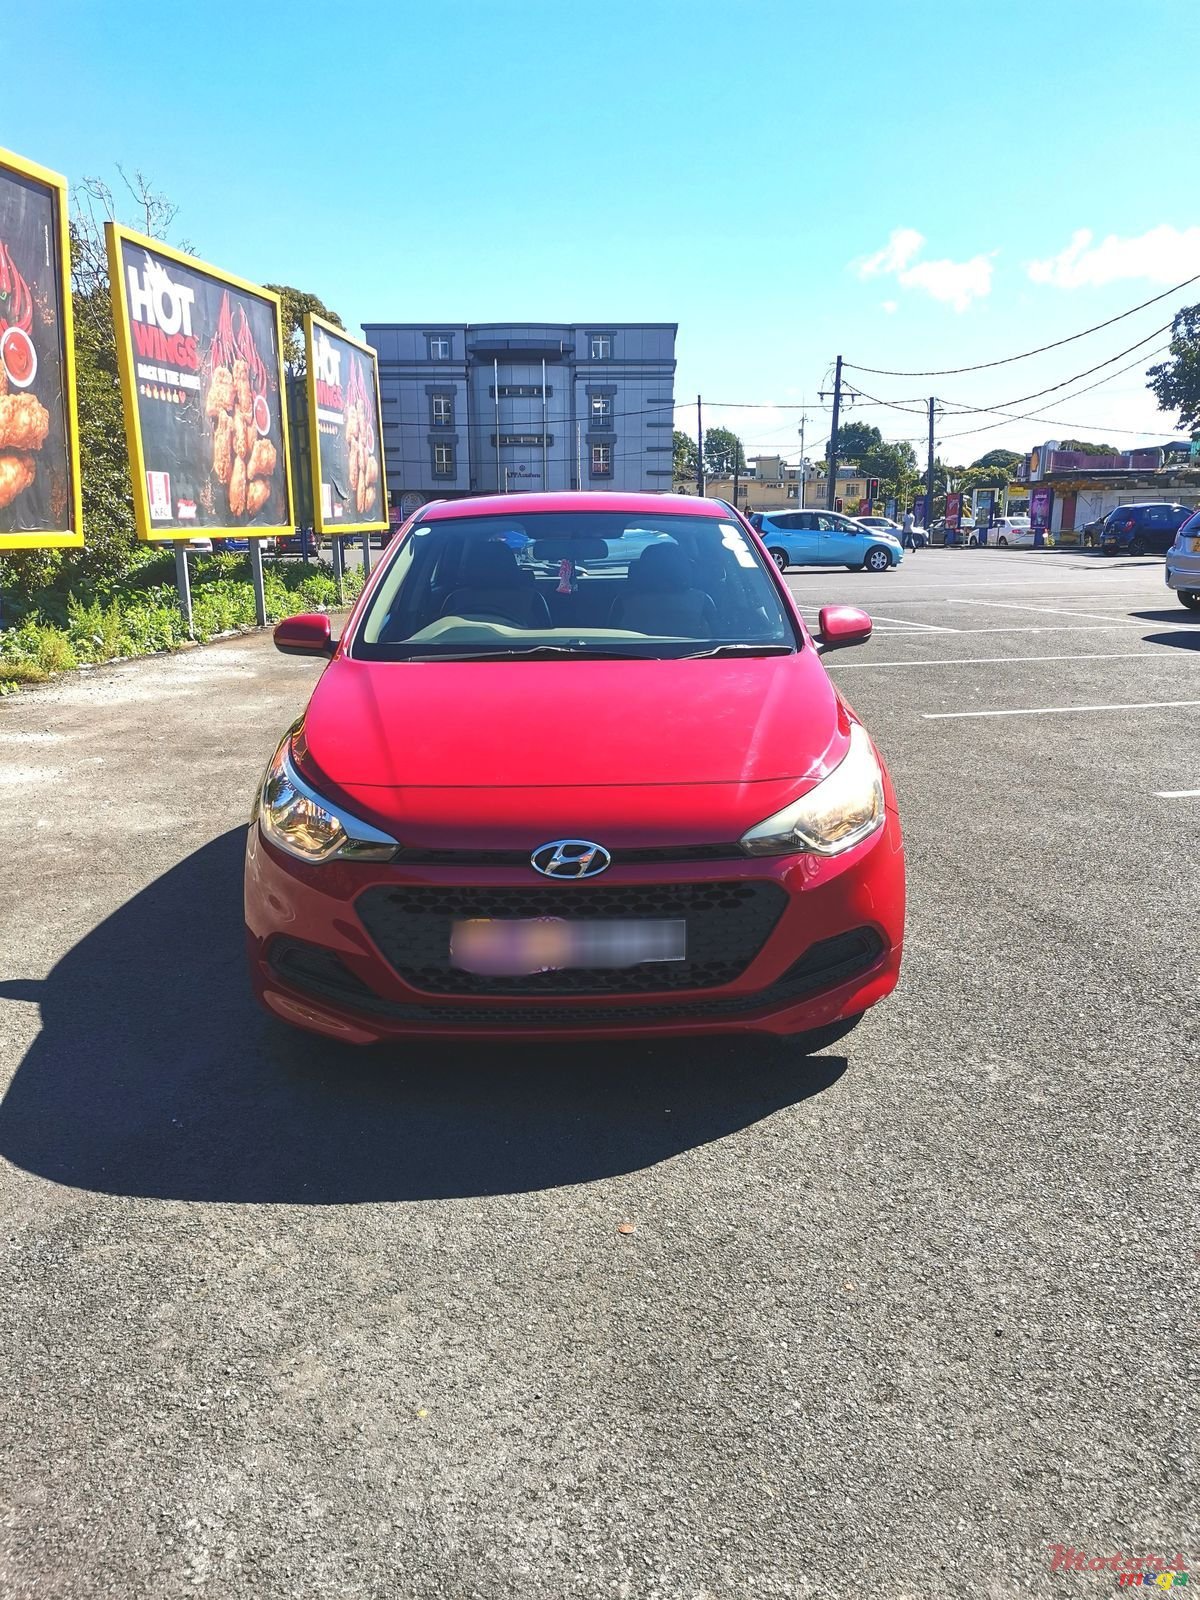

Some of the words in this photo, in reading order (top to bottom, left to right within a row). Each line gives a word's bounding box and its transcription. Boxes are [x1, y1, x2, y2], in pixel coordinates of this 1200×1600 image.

[127, 253, 195, 337] HOT
[132, 319, 199, 370] WINGS
[313, 332, 341, 387] HOT
